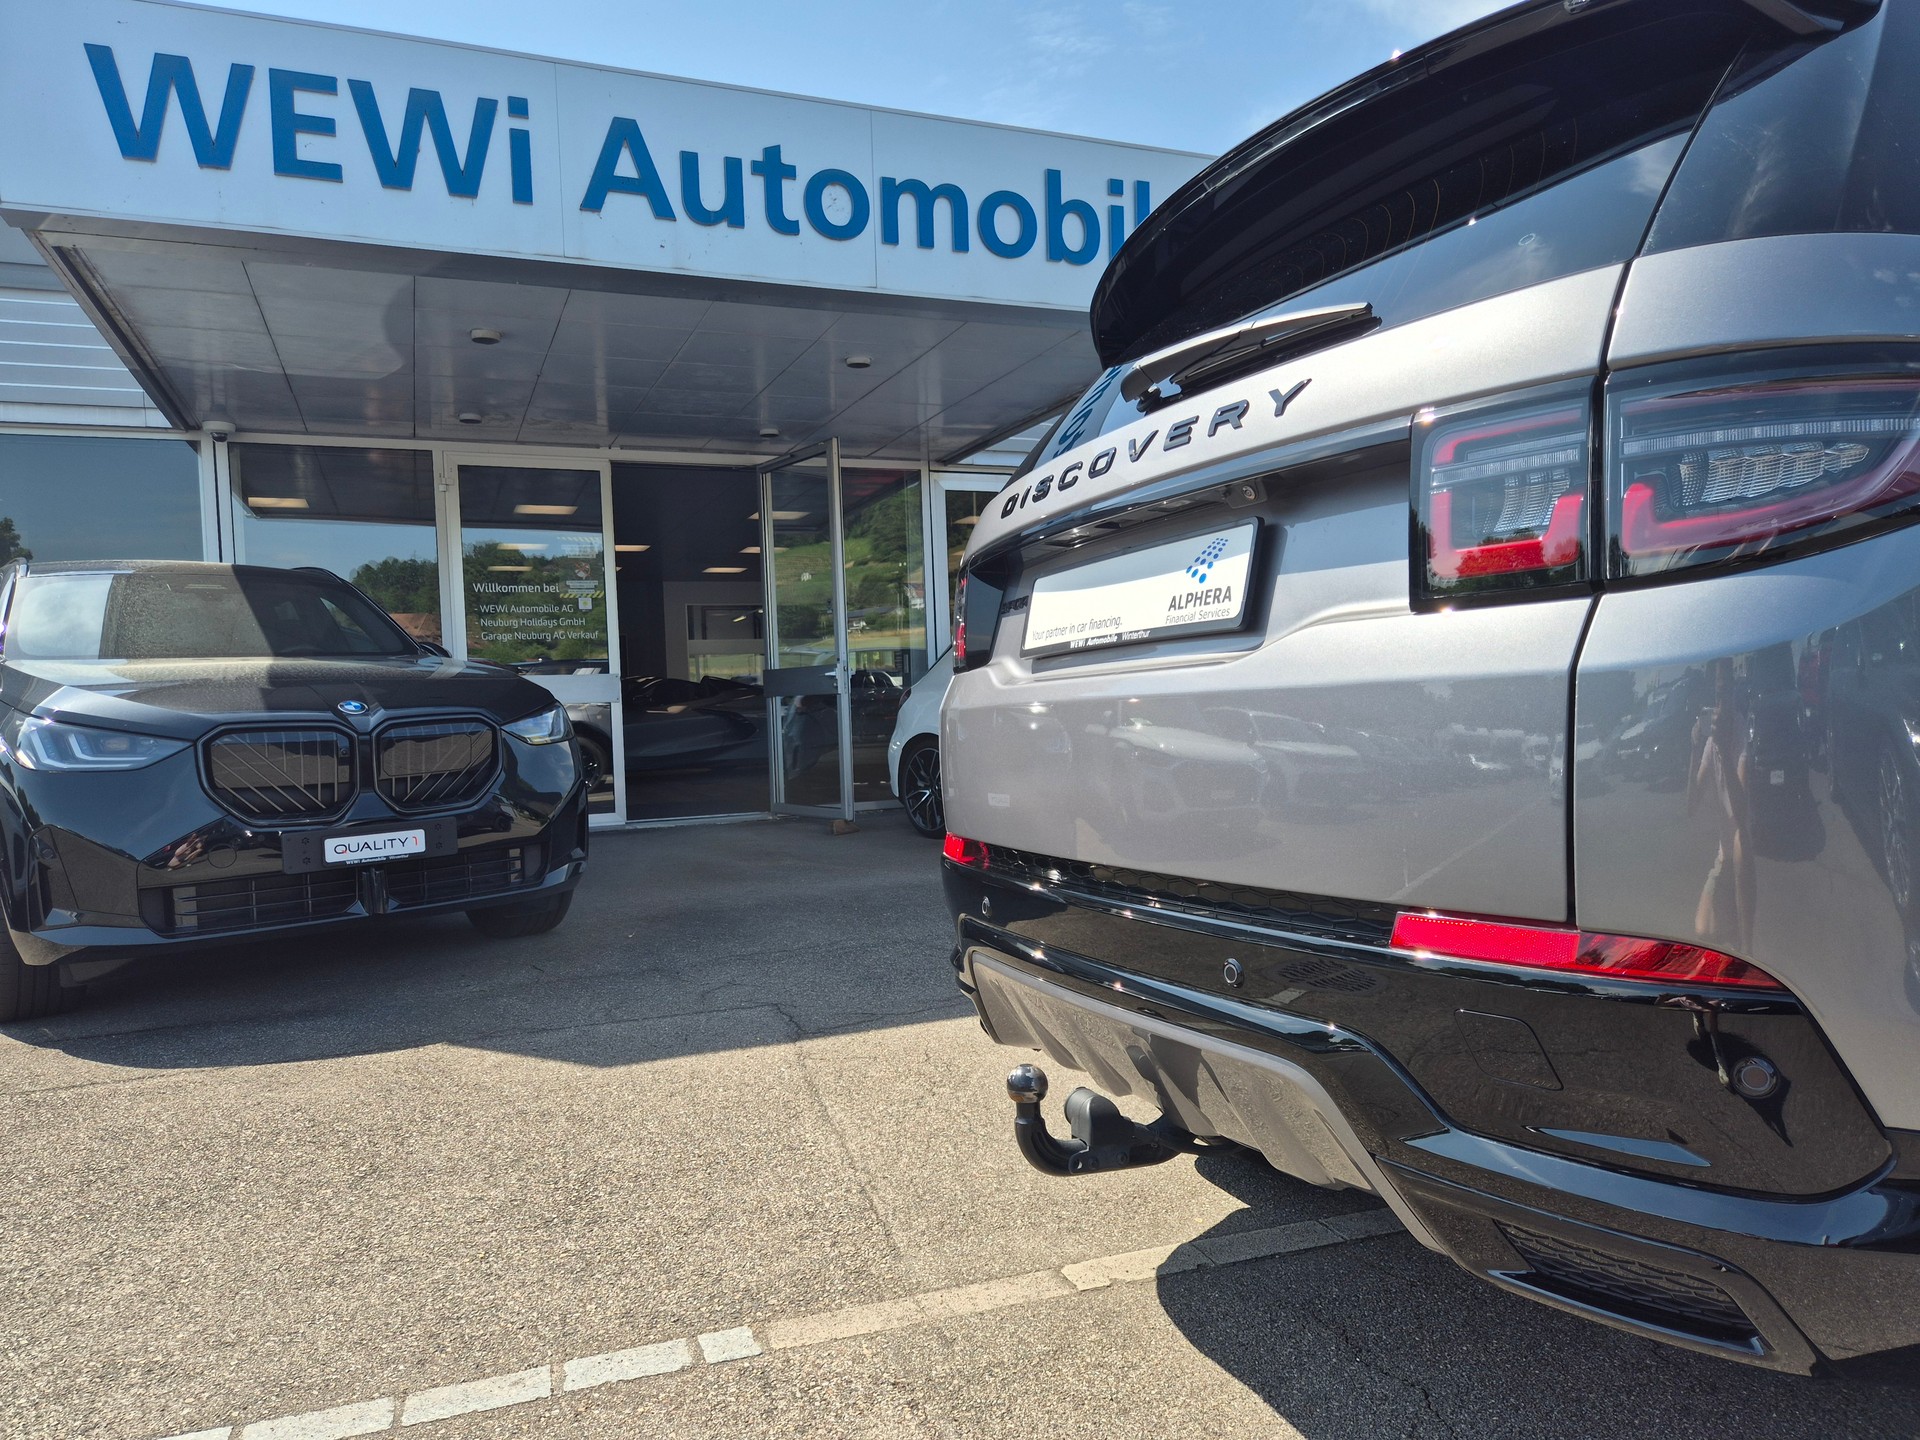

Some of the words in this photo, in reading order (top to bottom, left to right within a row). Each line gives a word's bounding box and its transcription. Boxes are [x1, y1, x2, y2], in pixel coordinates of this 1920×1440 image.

[83, 43, 533, 205] WEWi
[1000, 378, 1312, 519] DISCOVERY
[473, 582, 541, 593] Willkommen
[543, 582, 560, 593] bei
[1168, 585, 1232, 612] ALPHERA
[480, 604, 508, 613] WEWi
[510, 604, 559, 613] Automobile
[561, 604, 574, 613] AG
[1165, 611, 1197, 625] Financial
[1198, 608, 1231, 620] Services
[480, 618, 519, 628] Neuburg
[520, 618, 557, 628] Holidays
[559, 617, 586, 626] GmbH
[1032, 630, 1045, 641] Your
[1045, 626, 1068, 641] partner
[1069, 623, 1076, 634] in
[1076, 622, 1088, 633] car
[1088, 616, 1123, 630] financing.
[481, 631, 513, 642] Garage
[514, 631, 552, 642] Neuburg
[553, 631, 566, 639] AG
[567, 630, 599, 639] Verkauf
[1086, 634, 1118, 646] Automobile
[1121, 630, 1151, 641] Winterthur
[334, 837, 409, 854] QUALITY
